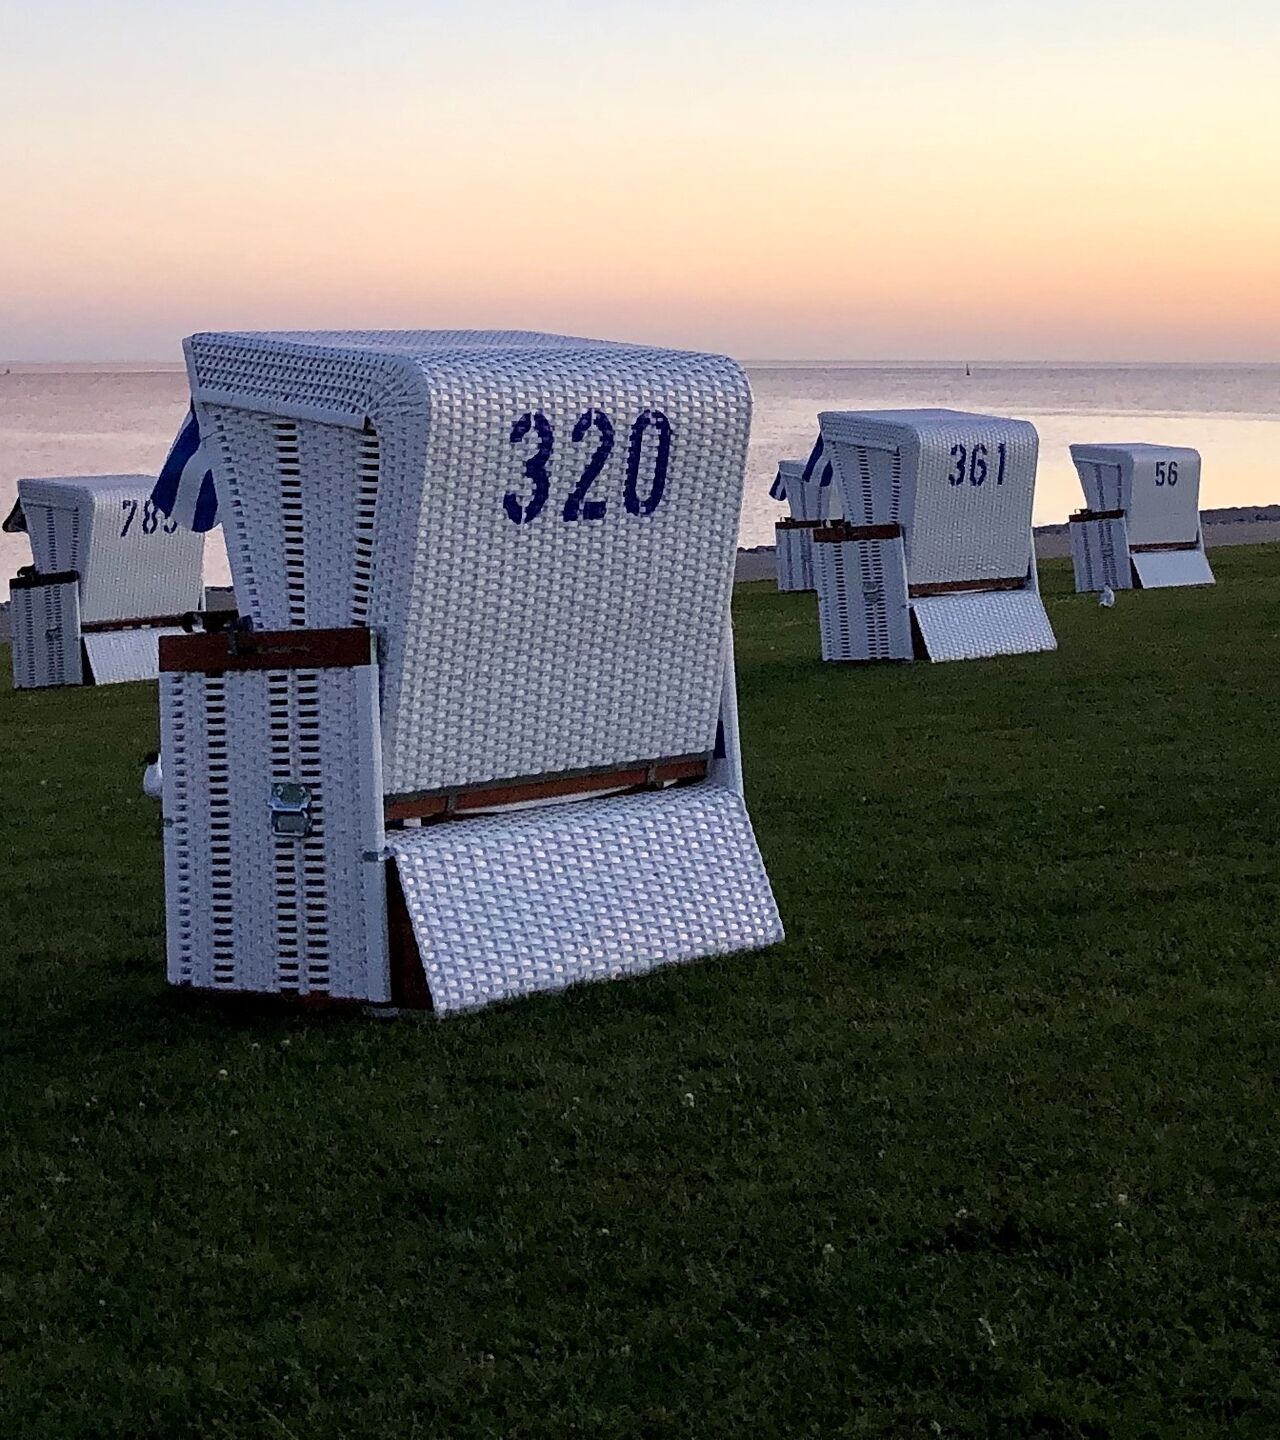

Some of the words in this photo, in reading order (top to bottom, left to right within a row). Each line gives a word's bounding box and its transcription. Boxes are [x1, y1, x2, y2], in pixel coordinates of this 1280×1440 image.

[503, 409, 671, 525] 320
[948, 443, 1006, 486] 361
[1155, 461, 1178, 486] 56
